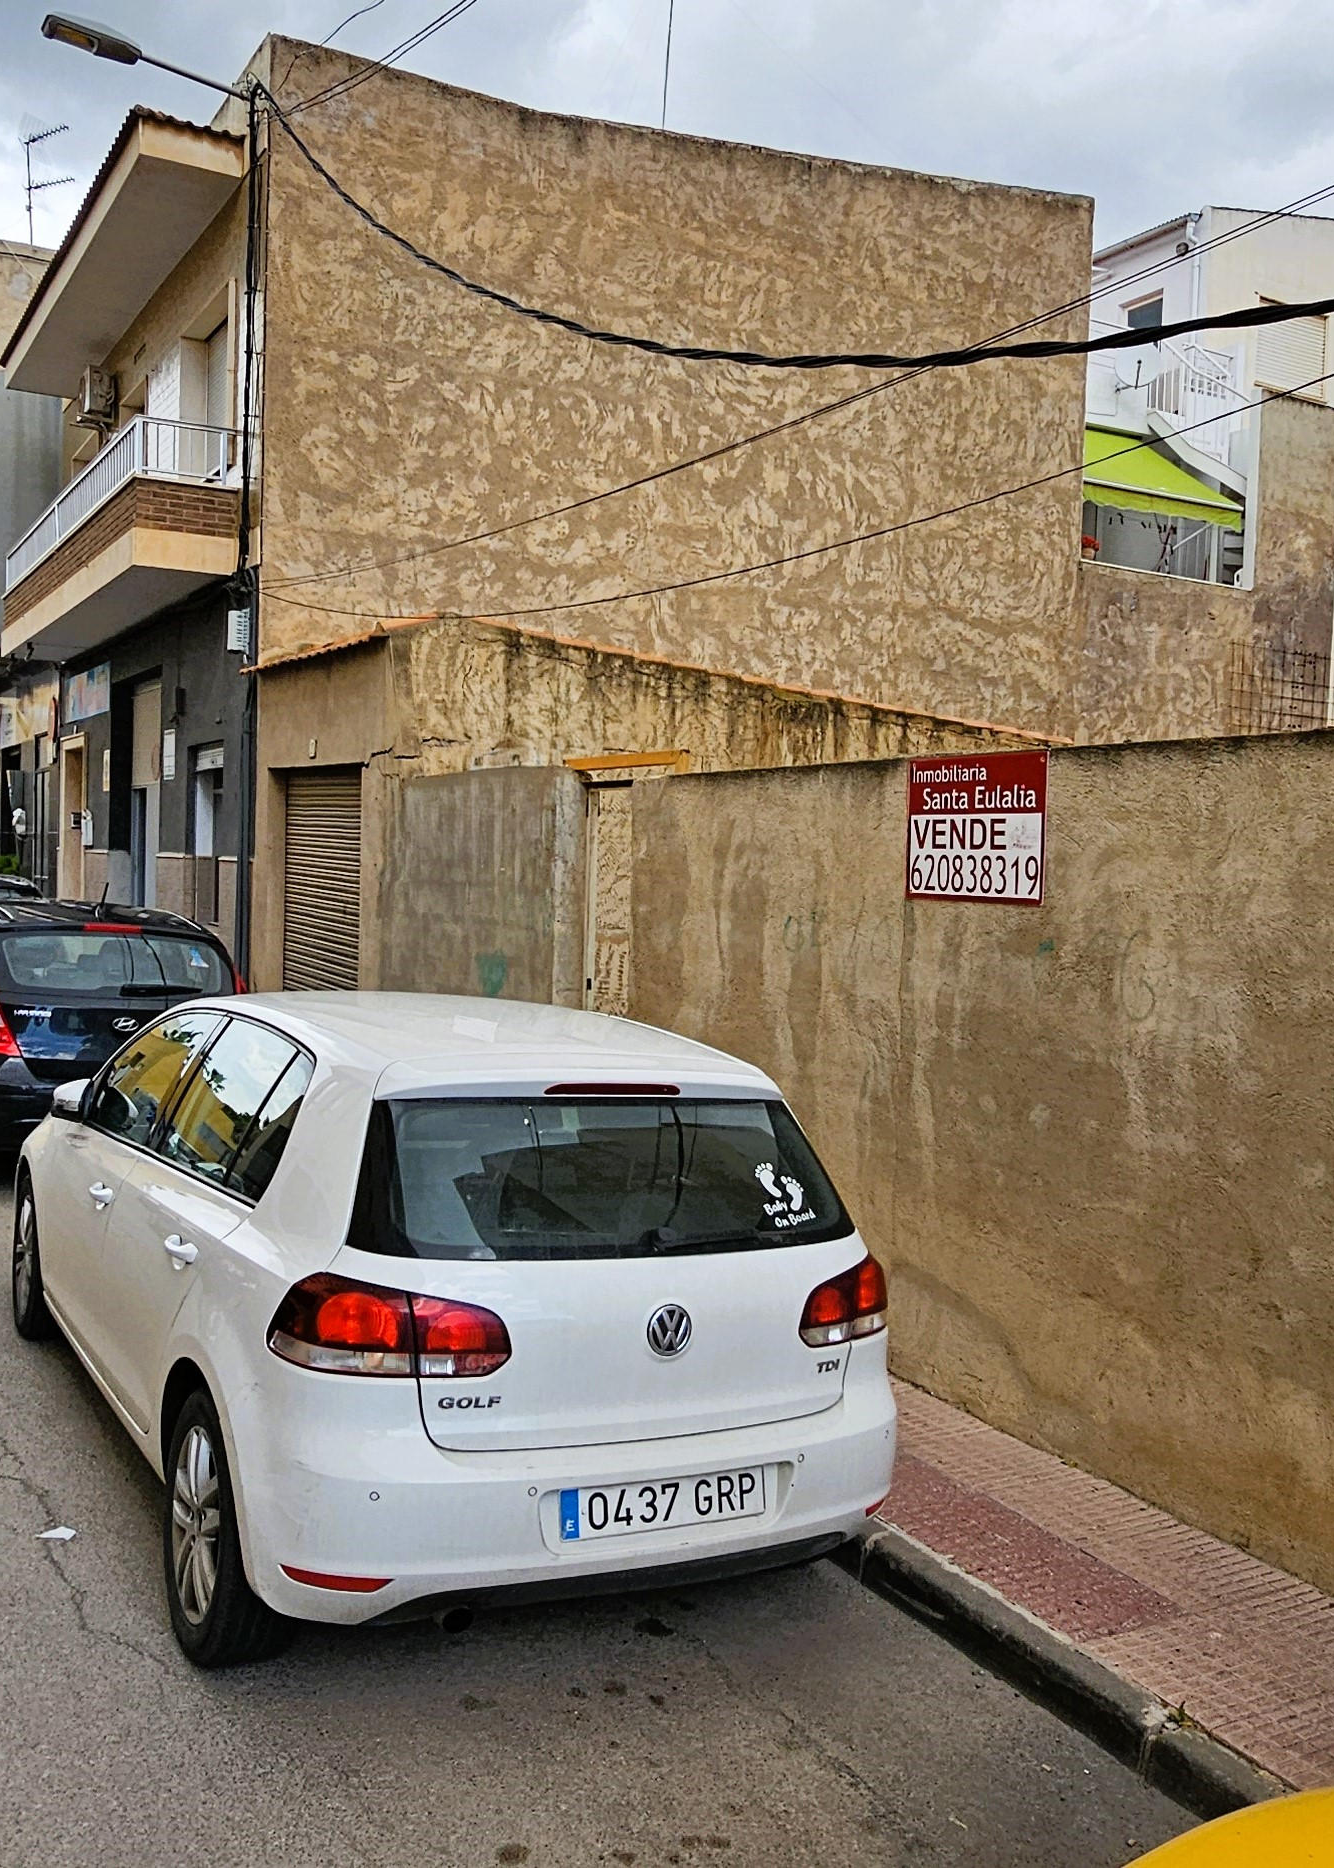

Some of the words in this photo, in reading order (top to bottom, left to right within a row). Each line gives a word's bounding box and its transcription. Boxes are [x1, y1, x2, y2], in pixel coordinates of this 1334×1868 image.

[912, 763, 987, 783] Inmobiliaria
[922, 788, 968, 810] Santa
[974, 784, 1036, 809] Eulalia
[913, 818, 1007, 850] VENDE
[911, 854, 1039, 896] 620838319
[763, 1200, 788, 1216] Baby
[774, 1216, 790, 1228] On
[787, 1208, 816, 1226] Board
[816, 1359, 840, 1374] TDI
[438, 1396, 501, 1409] GOLF
[588, 1482, 680, 1531] 0437
[694, 1472, 756, 1517] GRP
